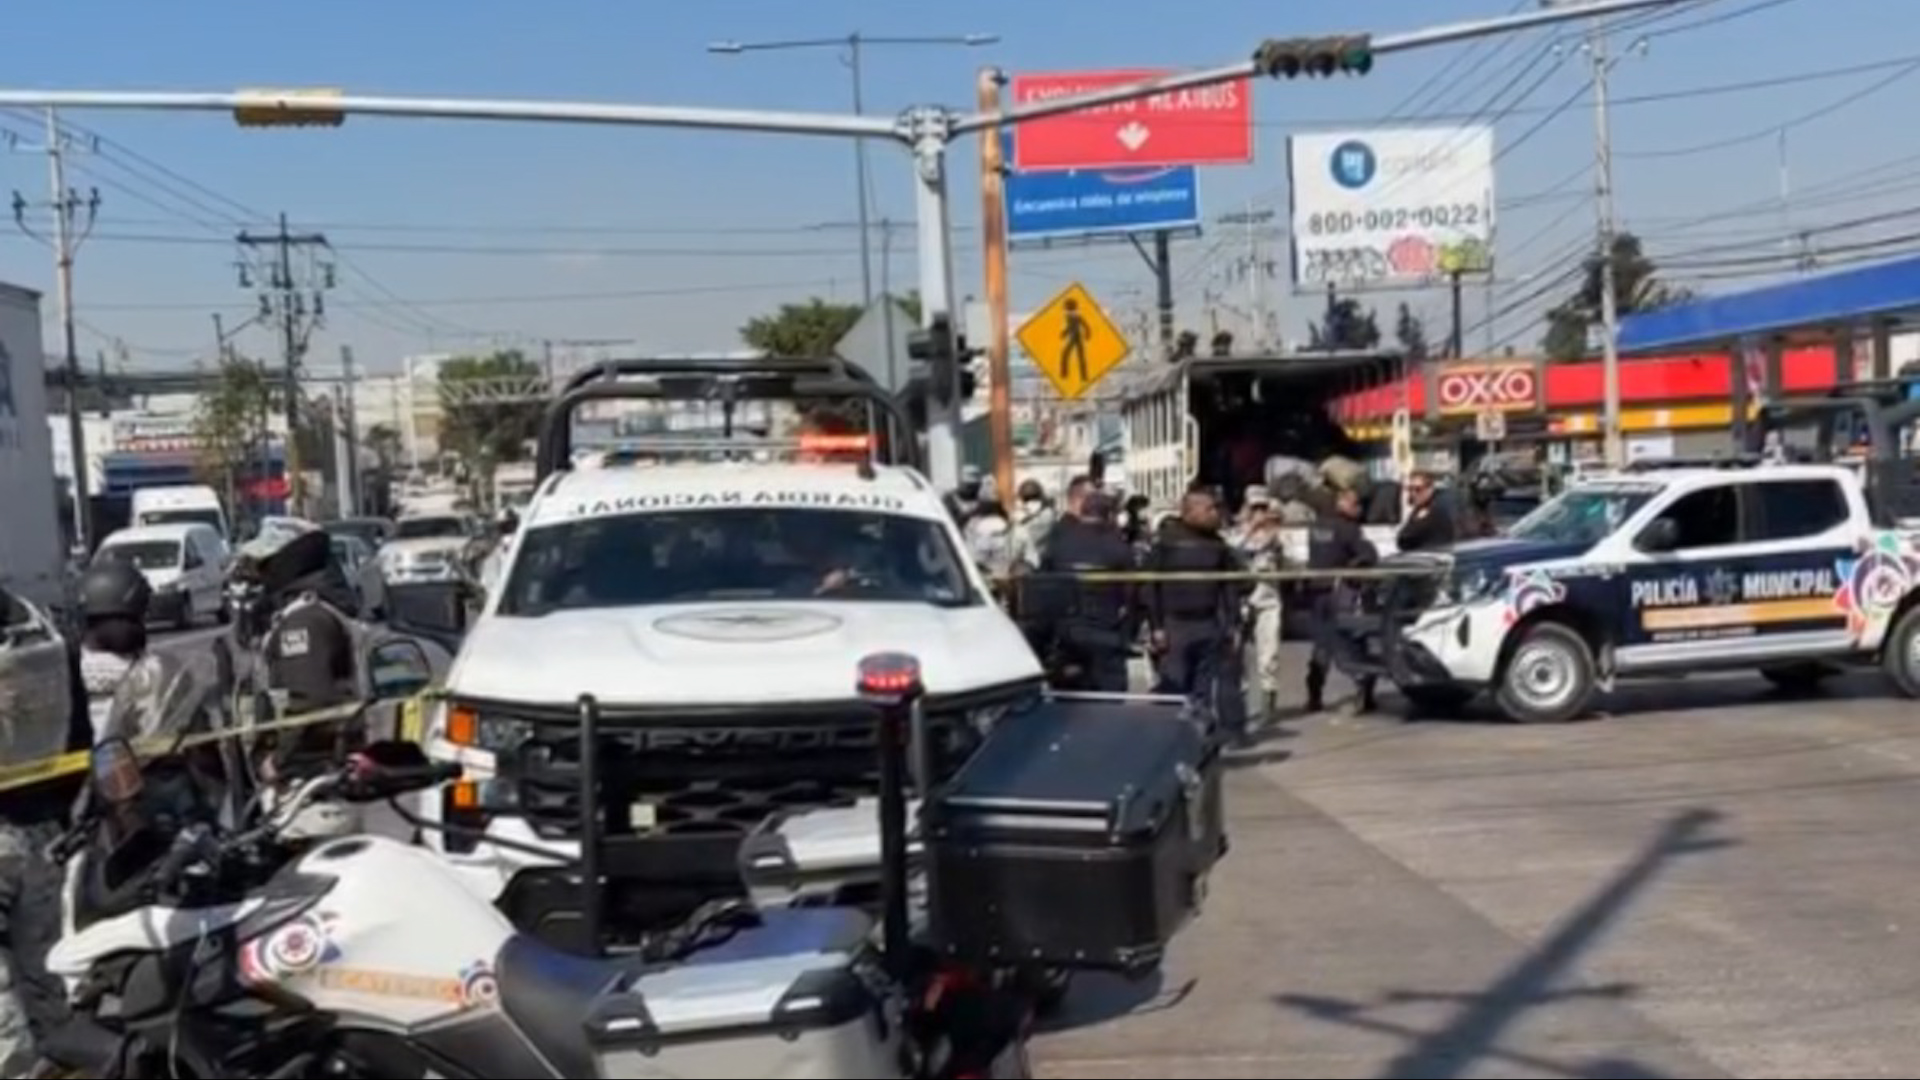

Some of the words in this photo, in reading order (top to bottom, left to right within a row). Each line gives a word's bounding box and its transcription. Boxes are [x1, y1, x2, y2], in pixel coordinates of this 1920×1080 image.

[1440, 366, 1534, 406] OXXO
[1631, 570, 1698, 606] POLICÍA
[1742, 568, 1834, 600] MUNICIPAL
